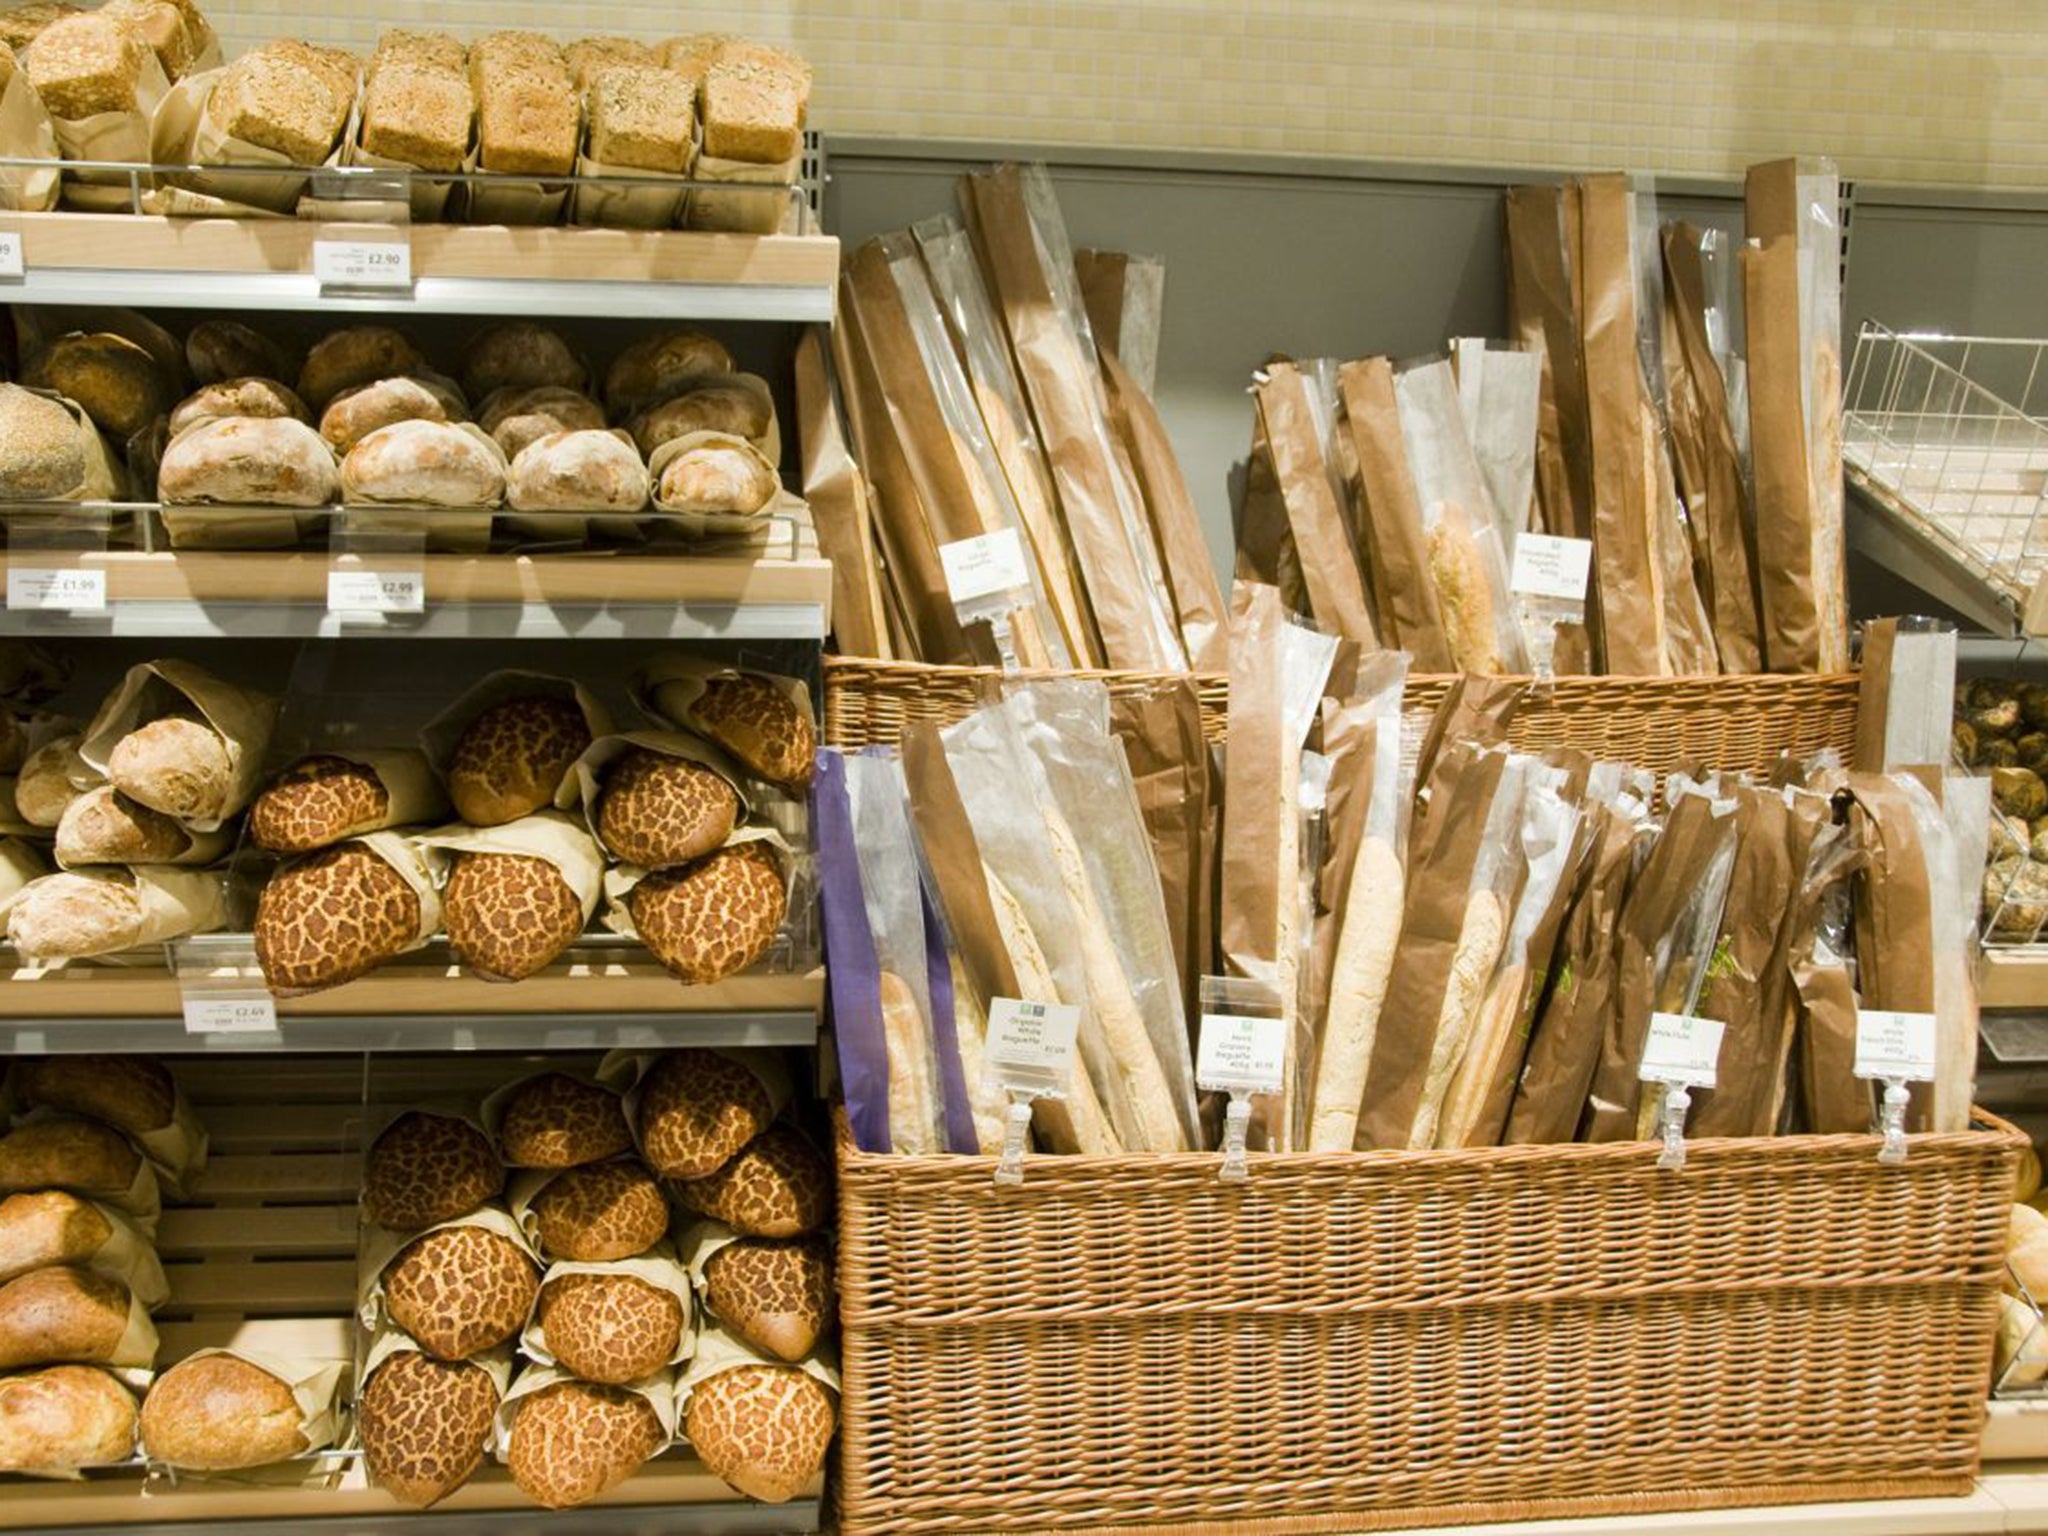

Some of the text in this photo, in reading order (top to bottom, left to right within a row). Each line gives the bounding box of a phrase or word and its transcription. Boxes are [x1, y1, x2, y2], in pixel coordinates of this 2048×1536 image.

[367, 252, 401, 265] £2.90
[62, 578, 96, 590] £1.99
[382, 581, 413, 593] £2.99
[235, 1006, 266, 1017] £2.69
[1001, 1034, 1041, 1045] Baguette
[1215, 1051, 1251, 1062] Baguette
